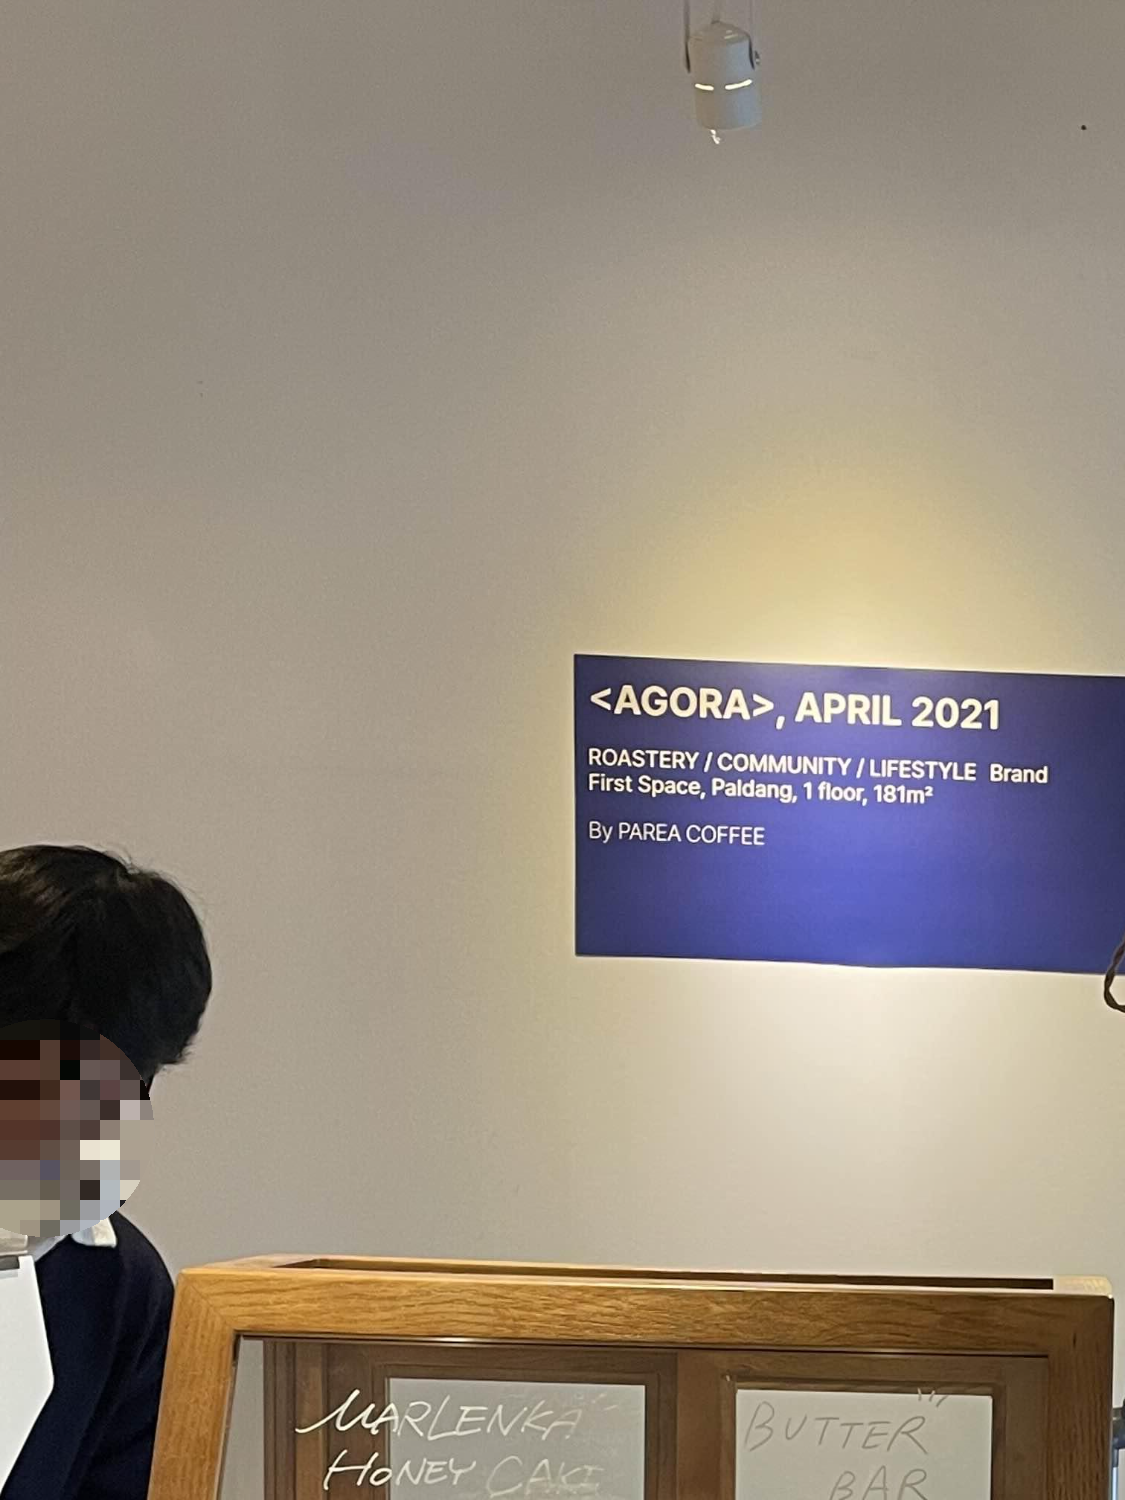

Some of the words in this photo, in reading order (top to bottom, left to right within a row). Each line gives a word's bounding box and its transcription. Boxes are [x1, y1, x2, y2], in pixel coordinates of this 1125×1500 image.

[794, 690, 902, 727] APRIL
[911, 695, 1001, 731] 2021
[587, 747, 700, 771] ROASTERY
[703, 751, 713, 773] /
[717, 752, 853, 777] COMMUNITY
[855, 757, 865, 779] /
[869, 758, 977, 782] LIFESTYLE
[989, 763, 1049, 785] Brand
[587, 772, 634, 794] First
[637, 774, 706, 800] Space,
[711, 777, 799, 803] Paldang,
[803, 781, 814, 800] 1
[817, 781, 869, 807] floor,
[588, 820, 613, 843] By
[618, 821, 682, 843] PAREA
[685, 824, 766, 847] COFFEE
[295, 1388, 583, 1441] MARLENKA
[742, 1400, 930, 1455] BUTTER
